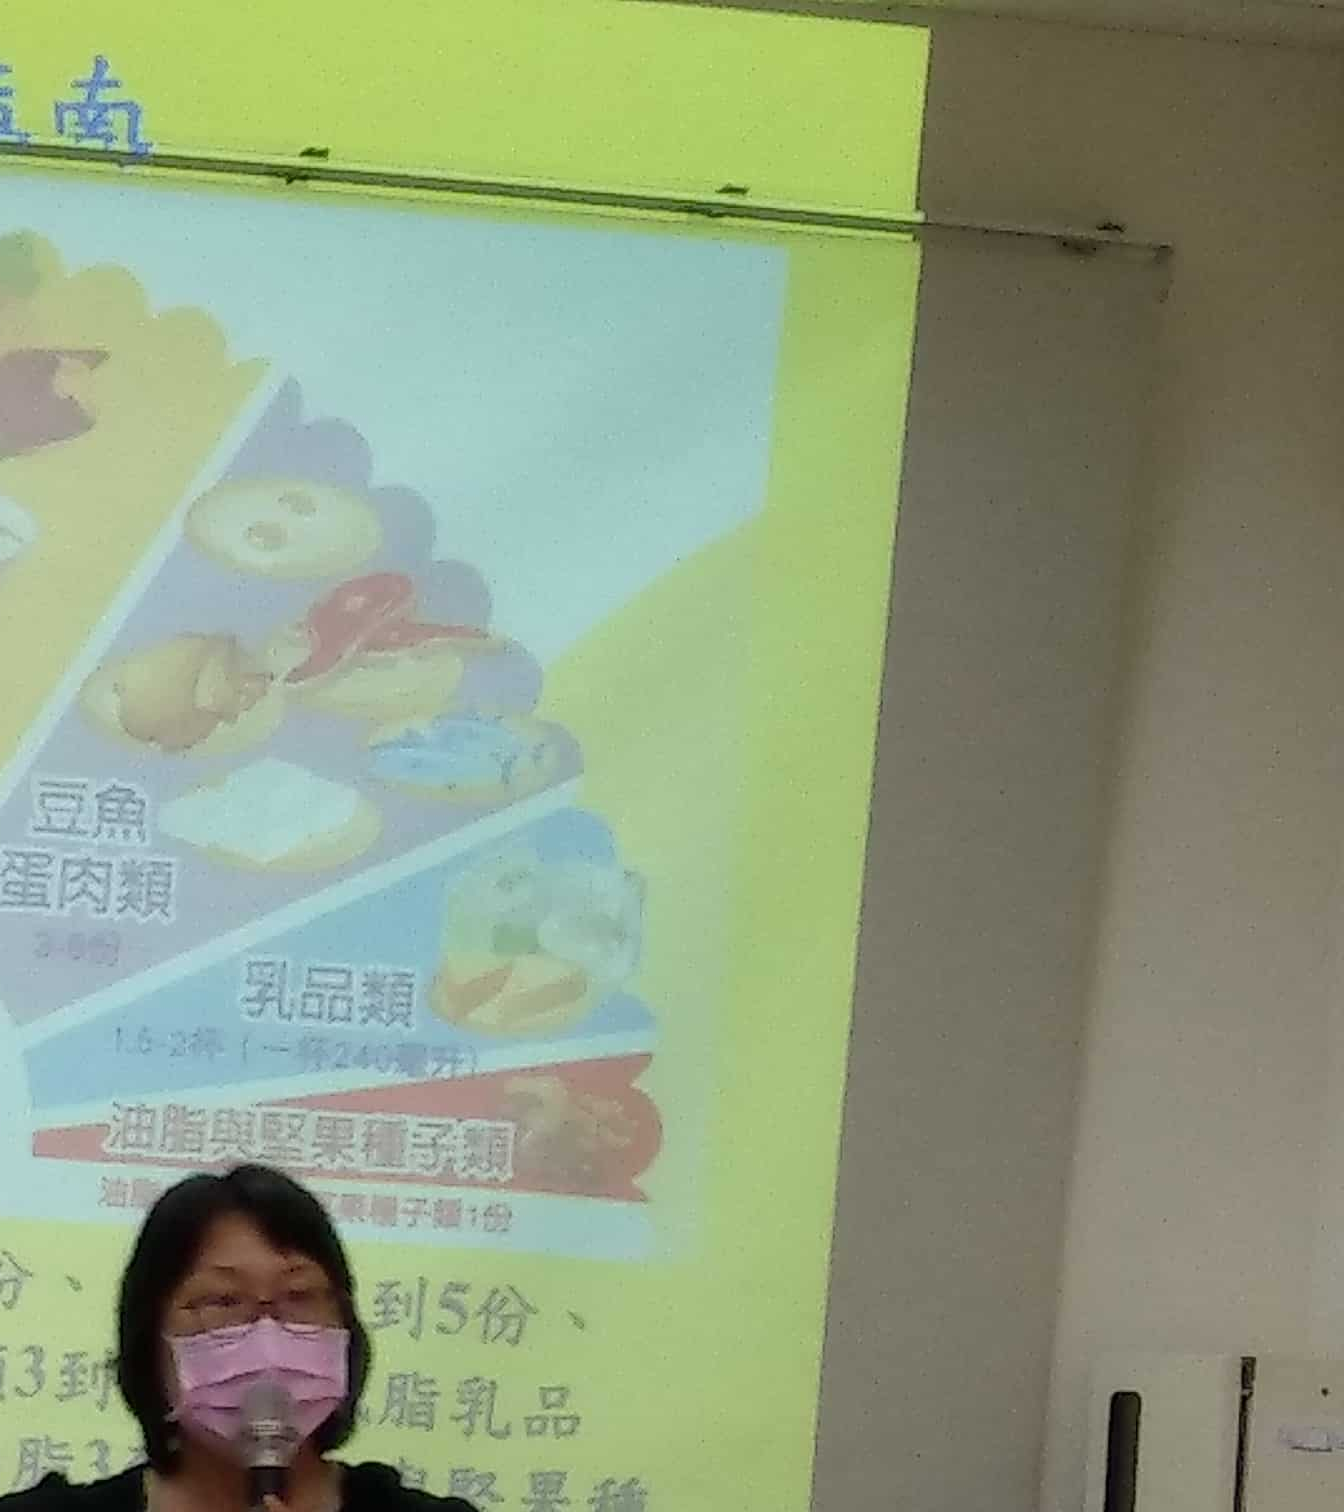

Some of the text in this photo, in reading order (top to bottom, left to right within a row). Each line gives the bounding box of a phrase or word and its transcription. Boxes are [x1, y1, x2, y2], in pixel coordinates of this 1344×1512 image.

[32, 779, 150, 843] 豆魚
[242, 960, 416, 1028] 乳品類
